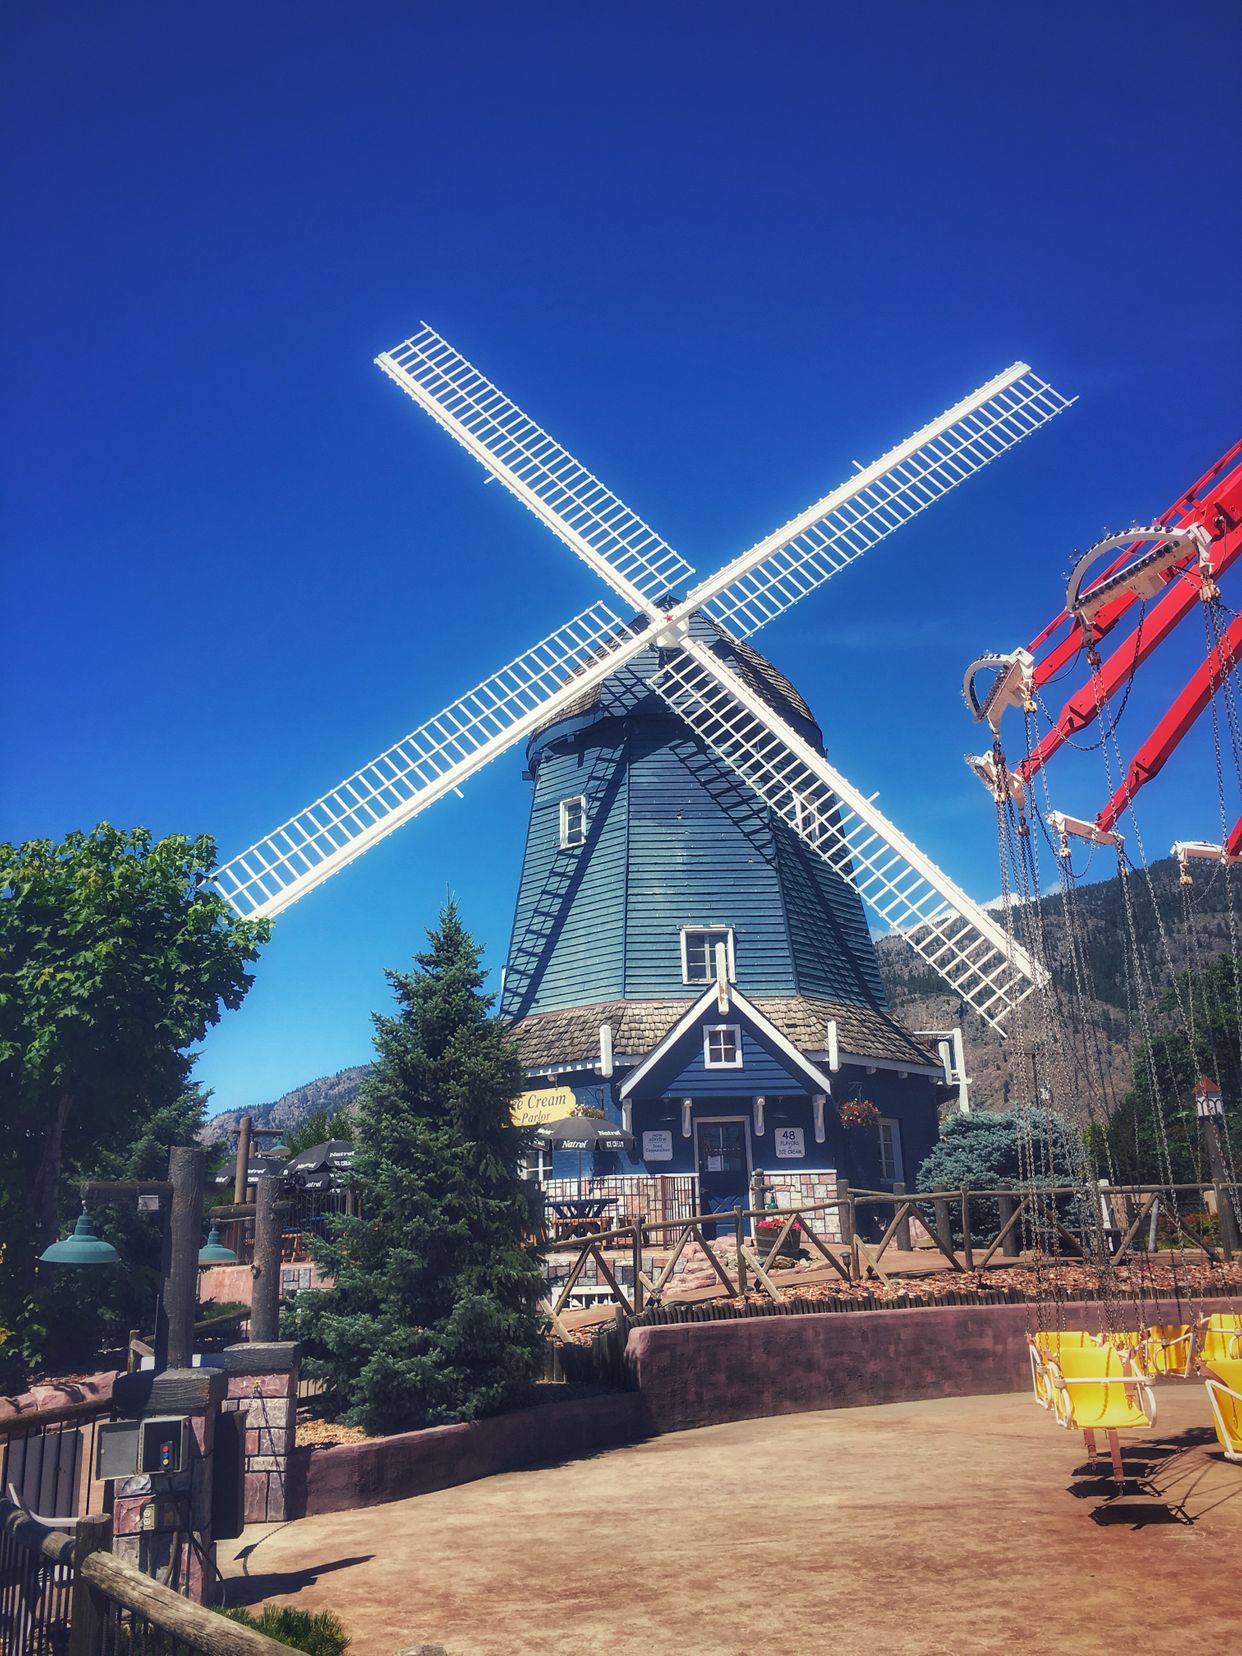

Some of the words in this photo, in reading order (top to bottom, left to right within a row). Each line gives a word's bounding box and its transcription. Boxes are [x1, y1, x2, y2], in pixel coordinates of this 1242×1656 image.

[527, 1094, 566, 1109] Cream
[521, 1110, 551, 1124] Parlor
[782, 1130, 796, 1140] 48
[561, 1139, 589, 1149] Natrel
